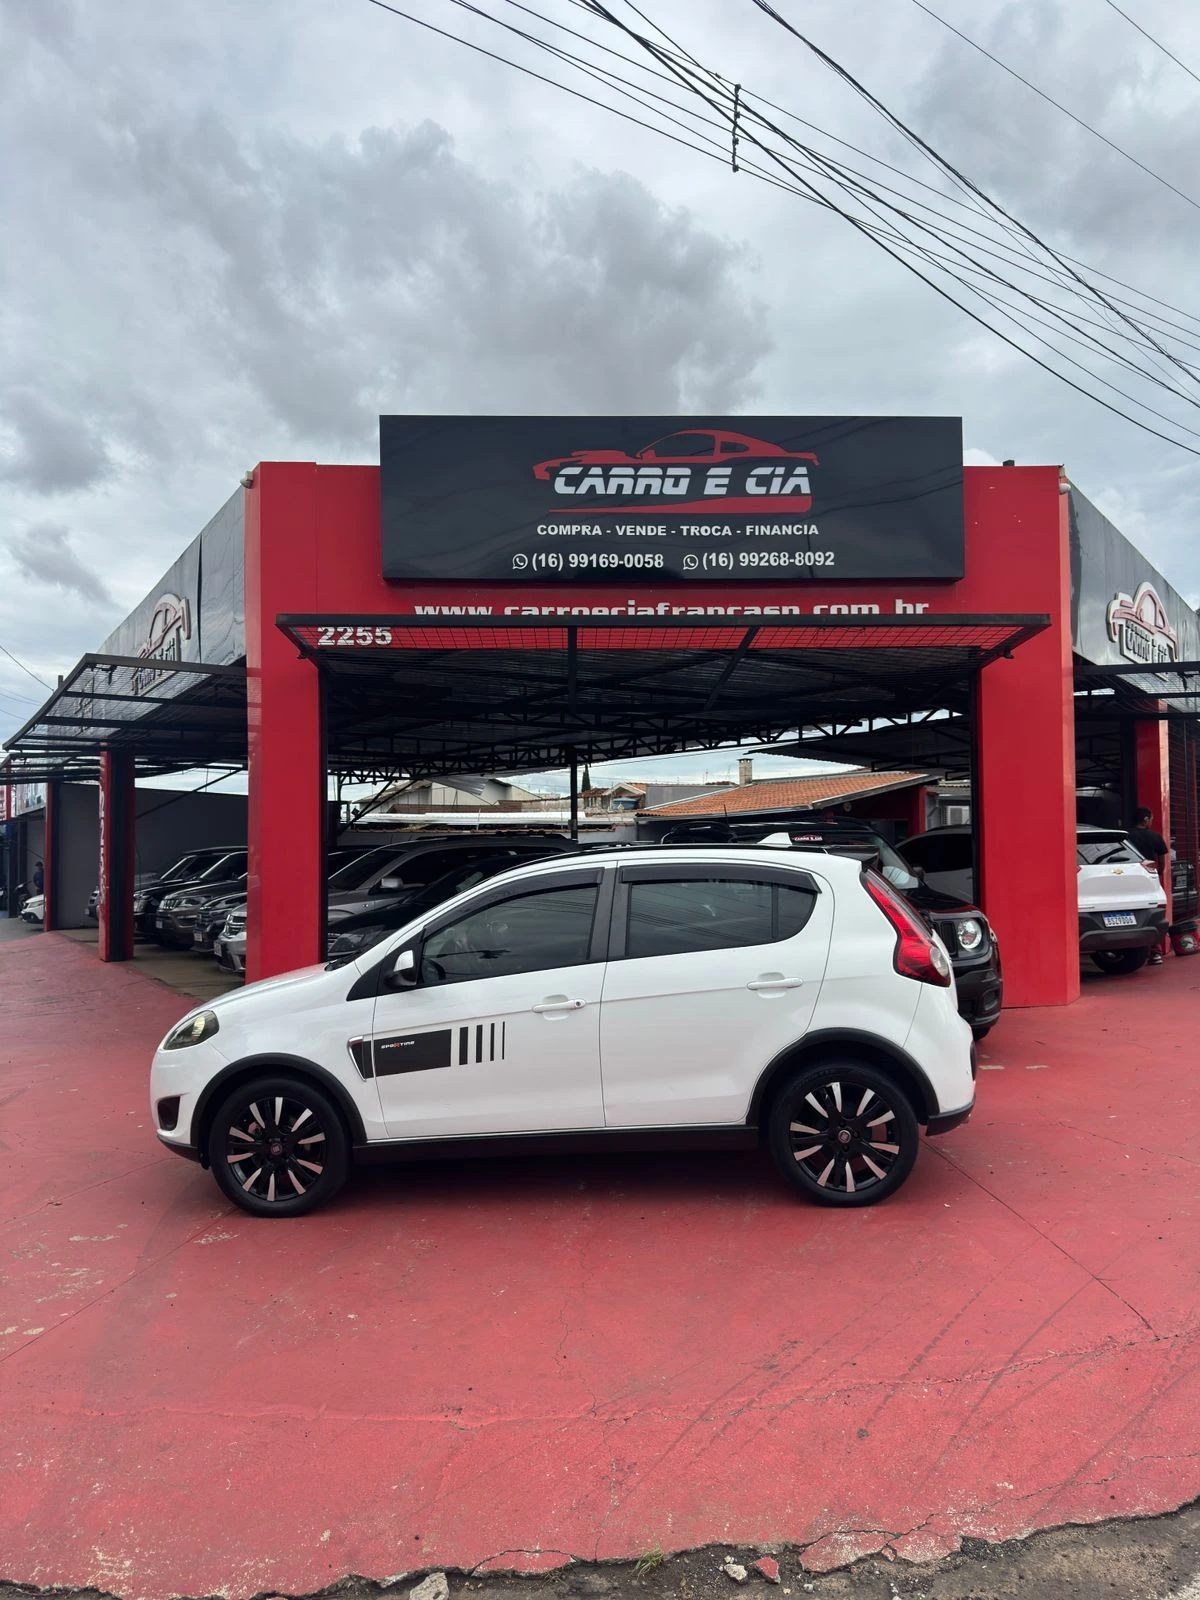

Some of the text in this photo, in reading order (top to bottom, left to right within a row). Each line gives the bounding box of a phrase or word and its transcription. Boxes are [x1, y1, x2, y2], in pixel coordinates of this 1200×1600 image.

[554, 466, 811, 495] CARRO E CIA
[536, 524, 603, 536] COMPRA
[615, 525, 667, 536] VENDE
[680, 525, 733, 536] TROCA
[745, 524, 819, 536] FINANCIA
[532, 553, 664, 571] (16) 99169-0058
[702, 551, 835, 570] (16) 99268-8092
[317, 626, 393, 646] 2255
